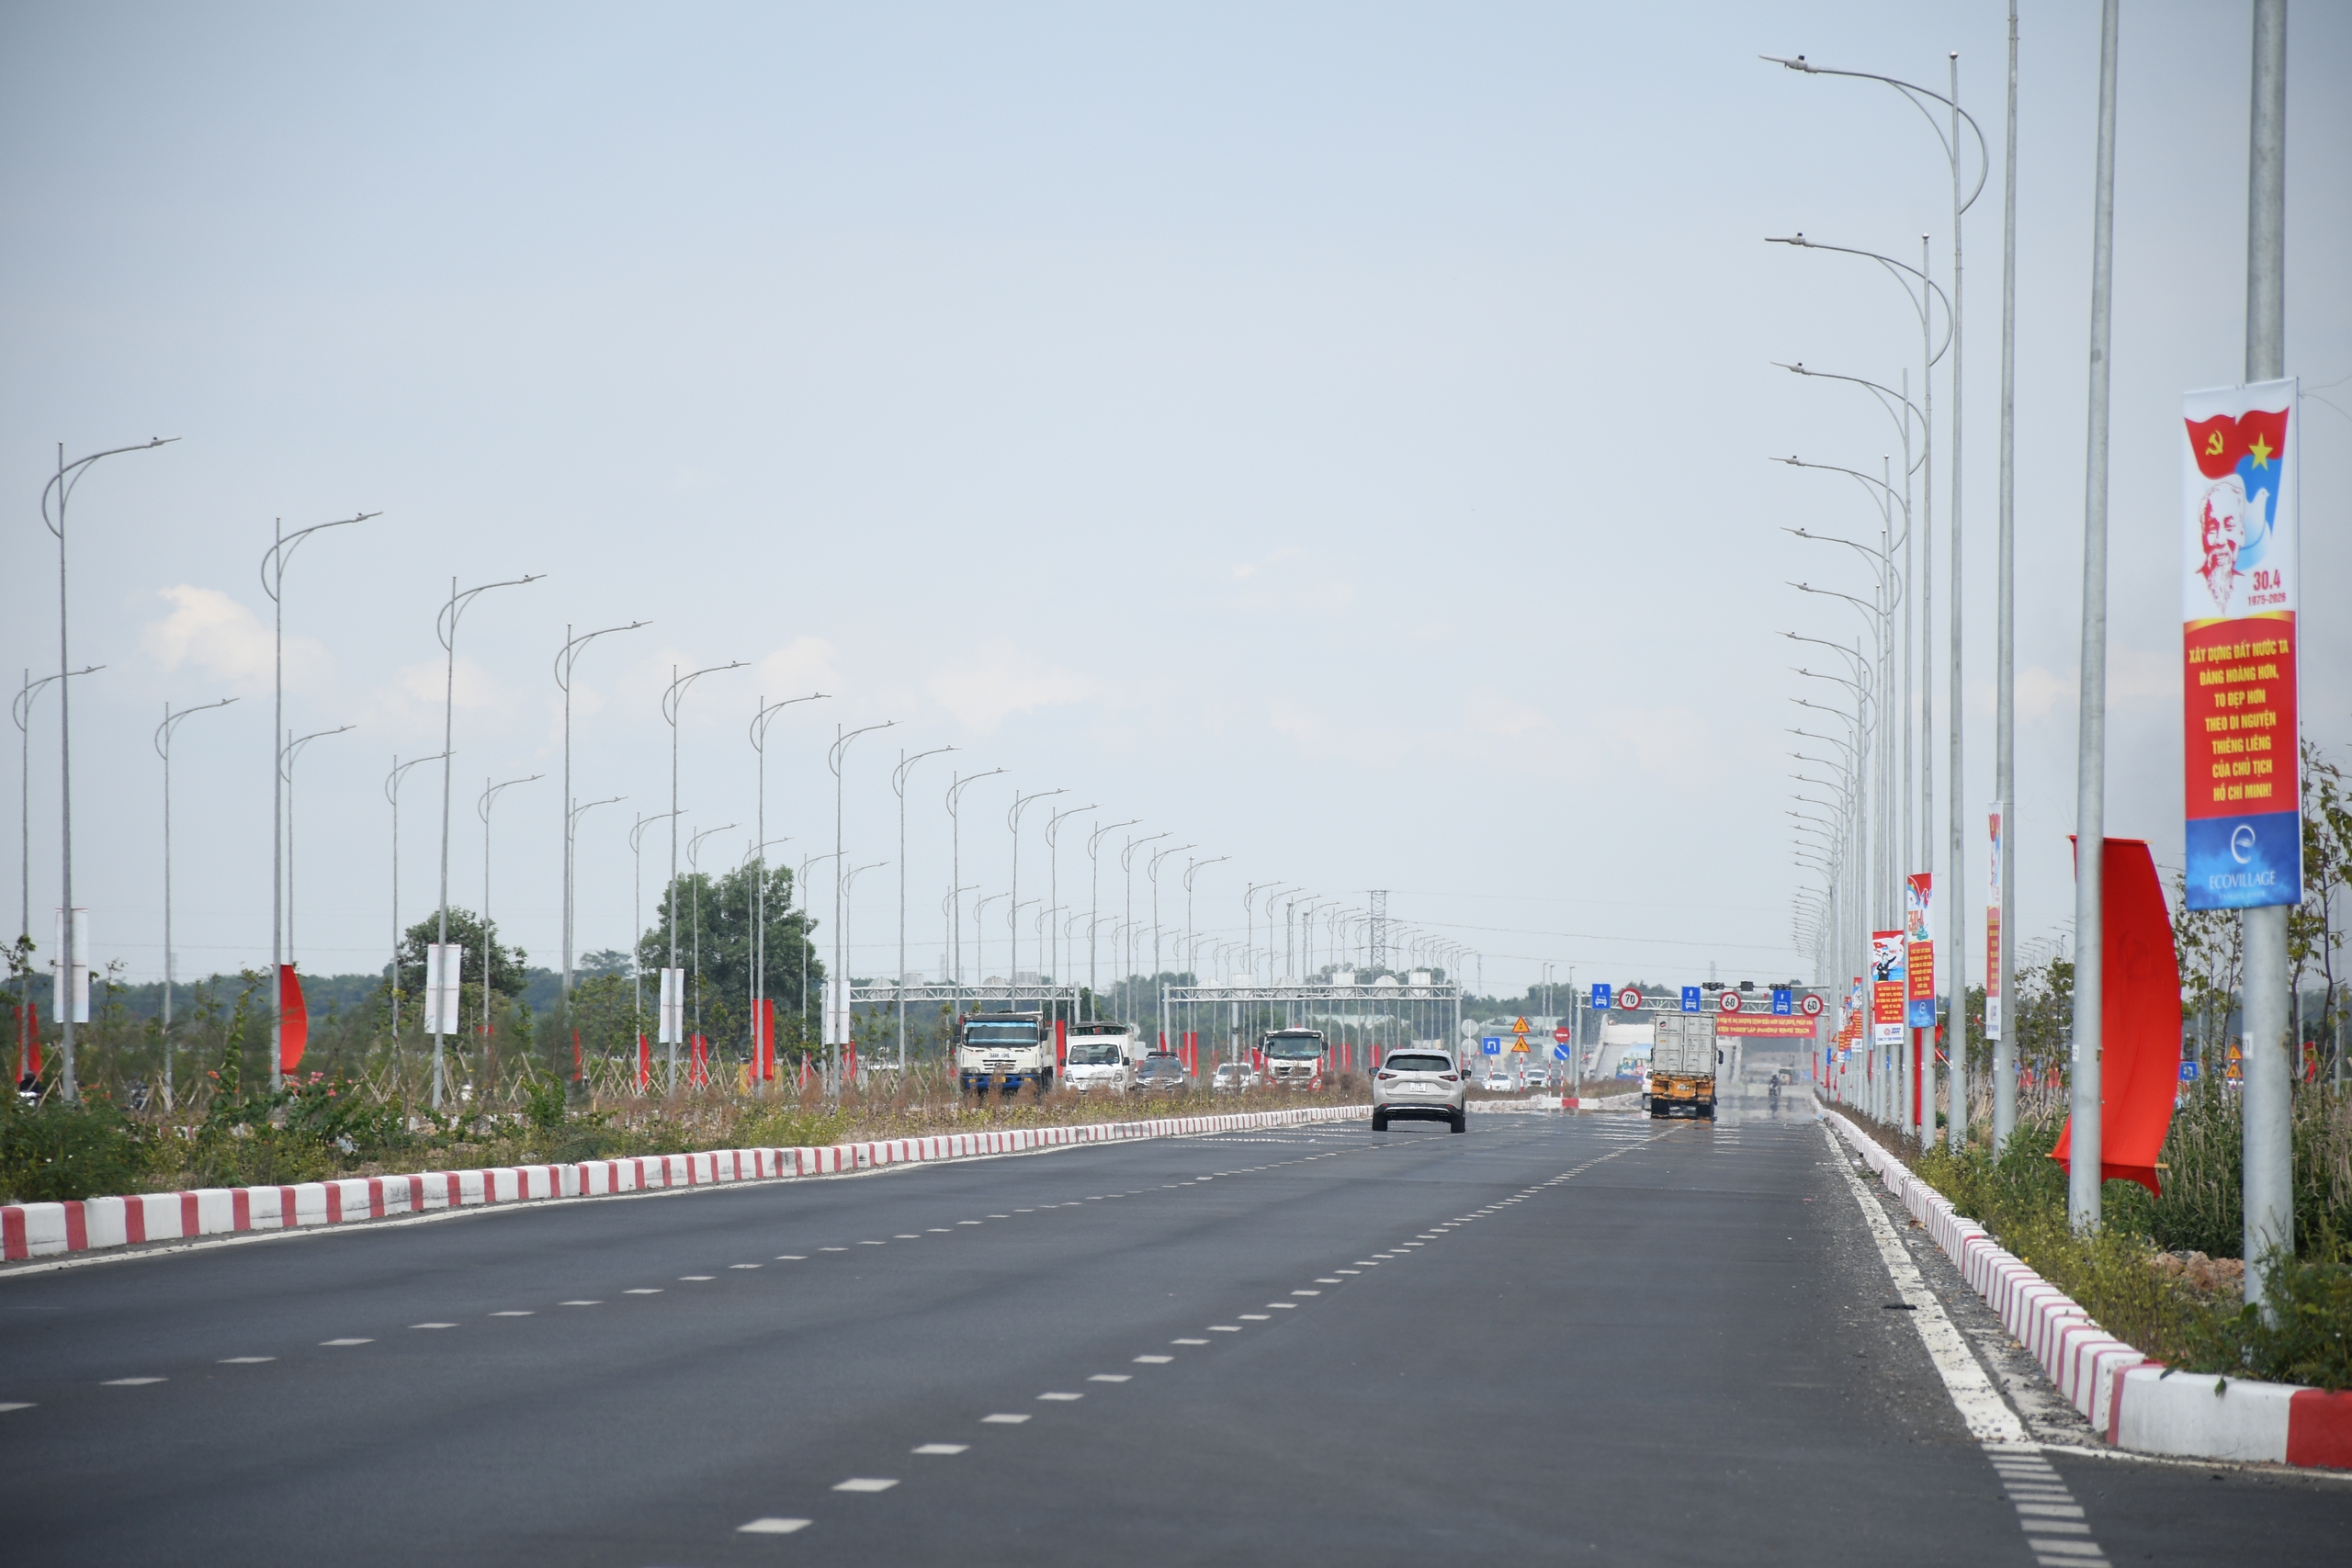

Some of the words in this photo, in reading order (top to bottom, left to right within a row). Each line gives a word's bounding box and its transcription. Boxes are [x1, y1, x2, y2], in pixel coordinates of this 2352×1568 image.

[2254, 570, 2280, 591] 30.4
[2188, 647, 2206, 664] XÂY
[2208, 646, 2233, 664] DỰNG
[2233, 639, 2250, 659] ĐẤT
[2252, 639, 2277, 657] NƯỚC
[2278, 639, 2289, 654] TA
[2199, 669, 2224, 686] ĐÀNG
[2226, 665, 2256, 683] HOÀNG
[2257, 663, 2279, 680] HƠN,
[2214, 693, 2225, 707] TO
[2227, 692, 2245, 709] ĐẸP
[2246, 688, 2266, 705] HƠN
[2205, 716, 2228, 732] THEO
[2230, 716, 2239, 730] DI
[2241, 710, 2277, 730] NGUYỆN
[2211, 737, 2244, 755] THIÊNG
[2245, 735, 2271, 752] LIÊNG
[2211, 760, 2231, 778] CỦA
[2232, 757, 2251, 776] CHỦ
[2252, 760, 2273, 777] TỊCH
[2213, 783, 2226, 802] HỒ
[2227, 783, 2243, 801] CHÍ
[2245, 783, 2272, 799] MINH!
[2209, 871, 2276, 890] ECOVILLAGE
[1624, 994, 1635, 1005] 70
[1724, 998, 1736, 1008] 60
[1807, 1000, 1817, 1010] 60
